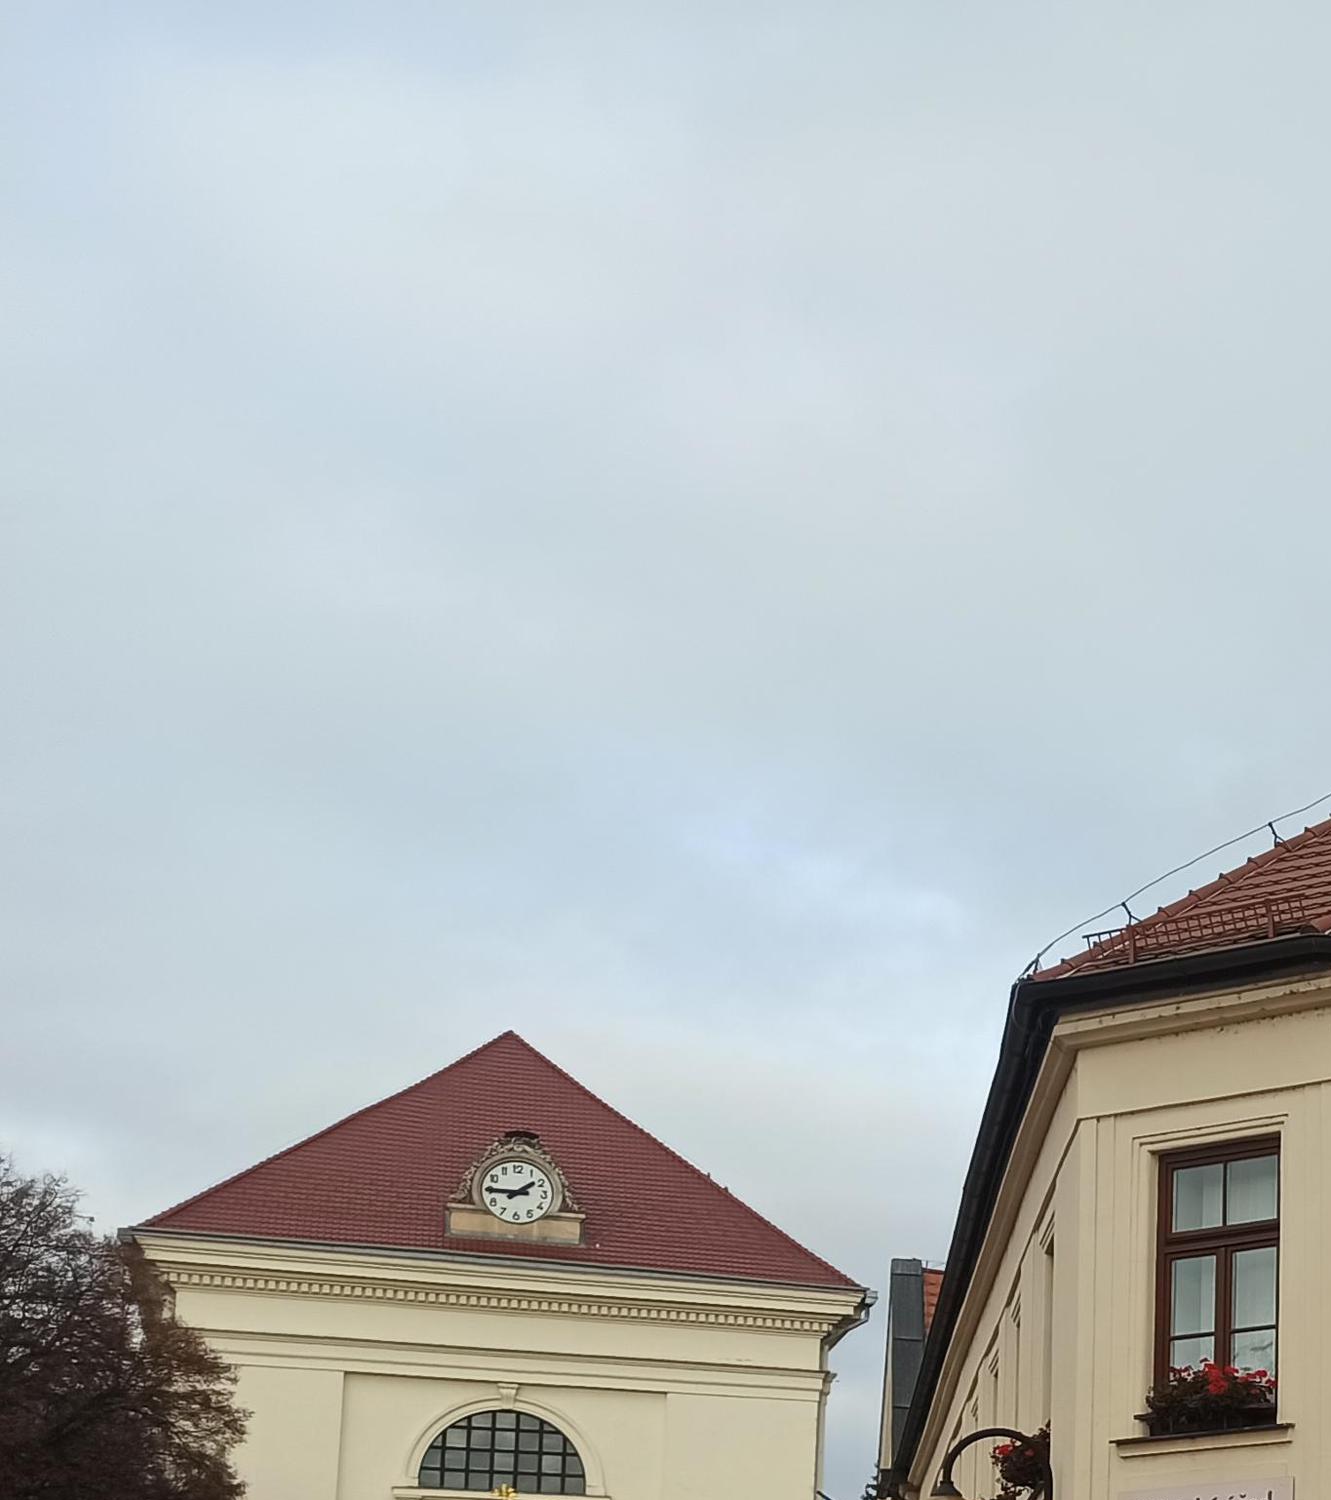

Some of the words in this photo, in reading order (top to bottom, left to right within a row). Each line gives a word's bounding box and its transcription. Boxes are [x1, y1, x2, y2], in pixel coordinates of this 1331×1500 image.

[501, 1166, 508, 1176] 11
[513, 1165, 523, 1174] 12
[490, 1174, 499, 1183] 10
[537, 1178, 545, 1187] 2
[540, 1190, 548, 1200] 3
[489, 1197, 497, 1207] 8
[536, 1202, 544, 1210] 4
[500, 1206, 507, 1216] 7
[512, 1211, 520, 1220] 6
[526, 1209, 534, 1218] 5
